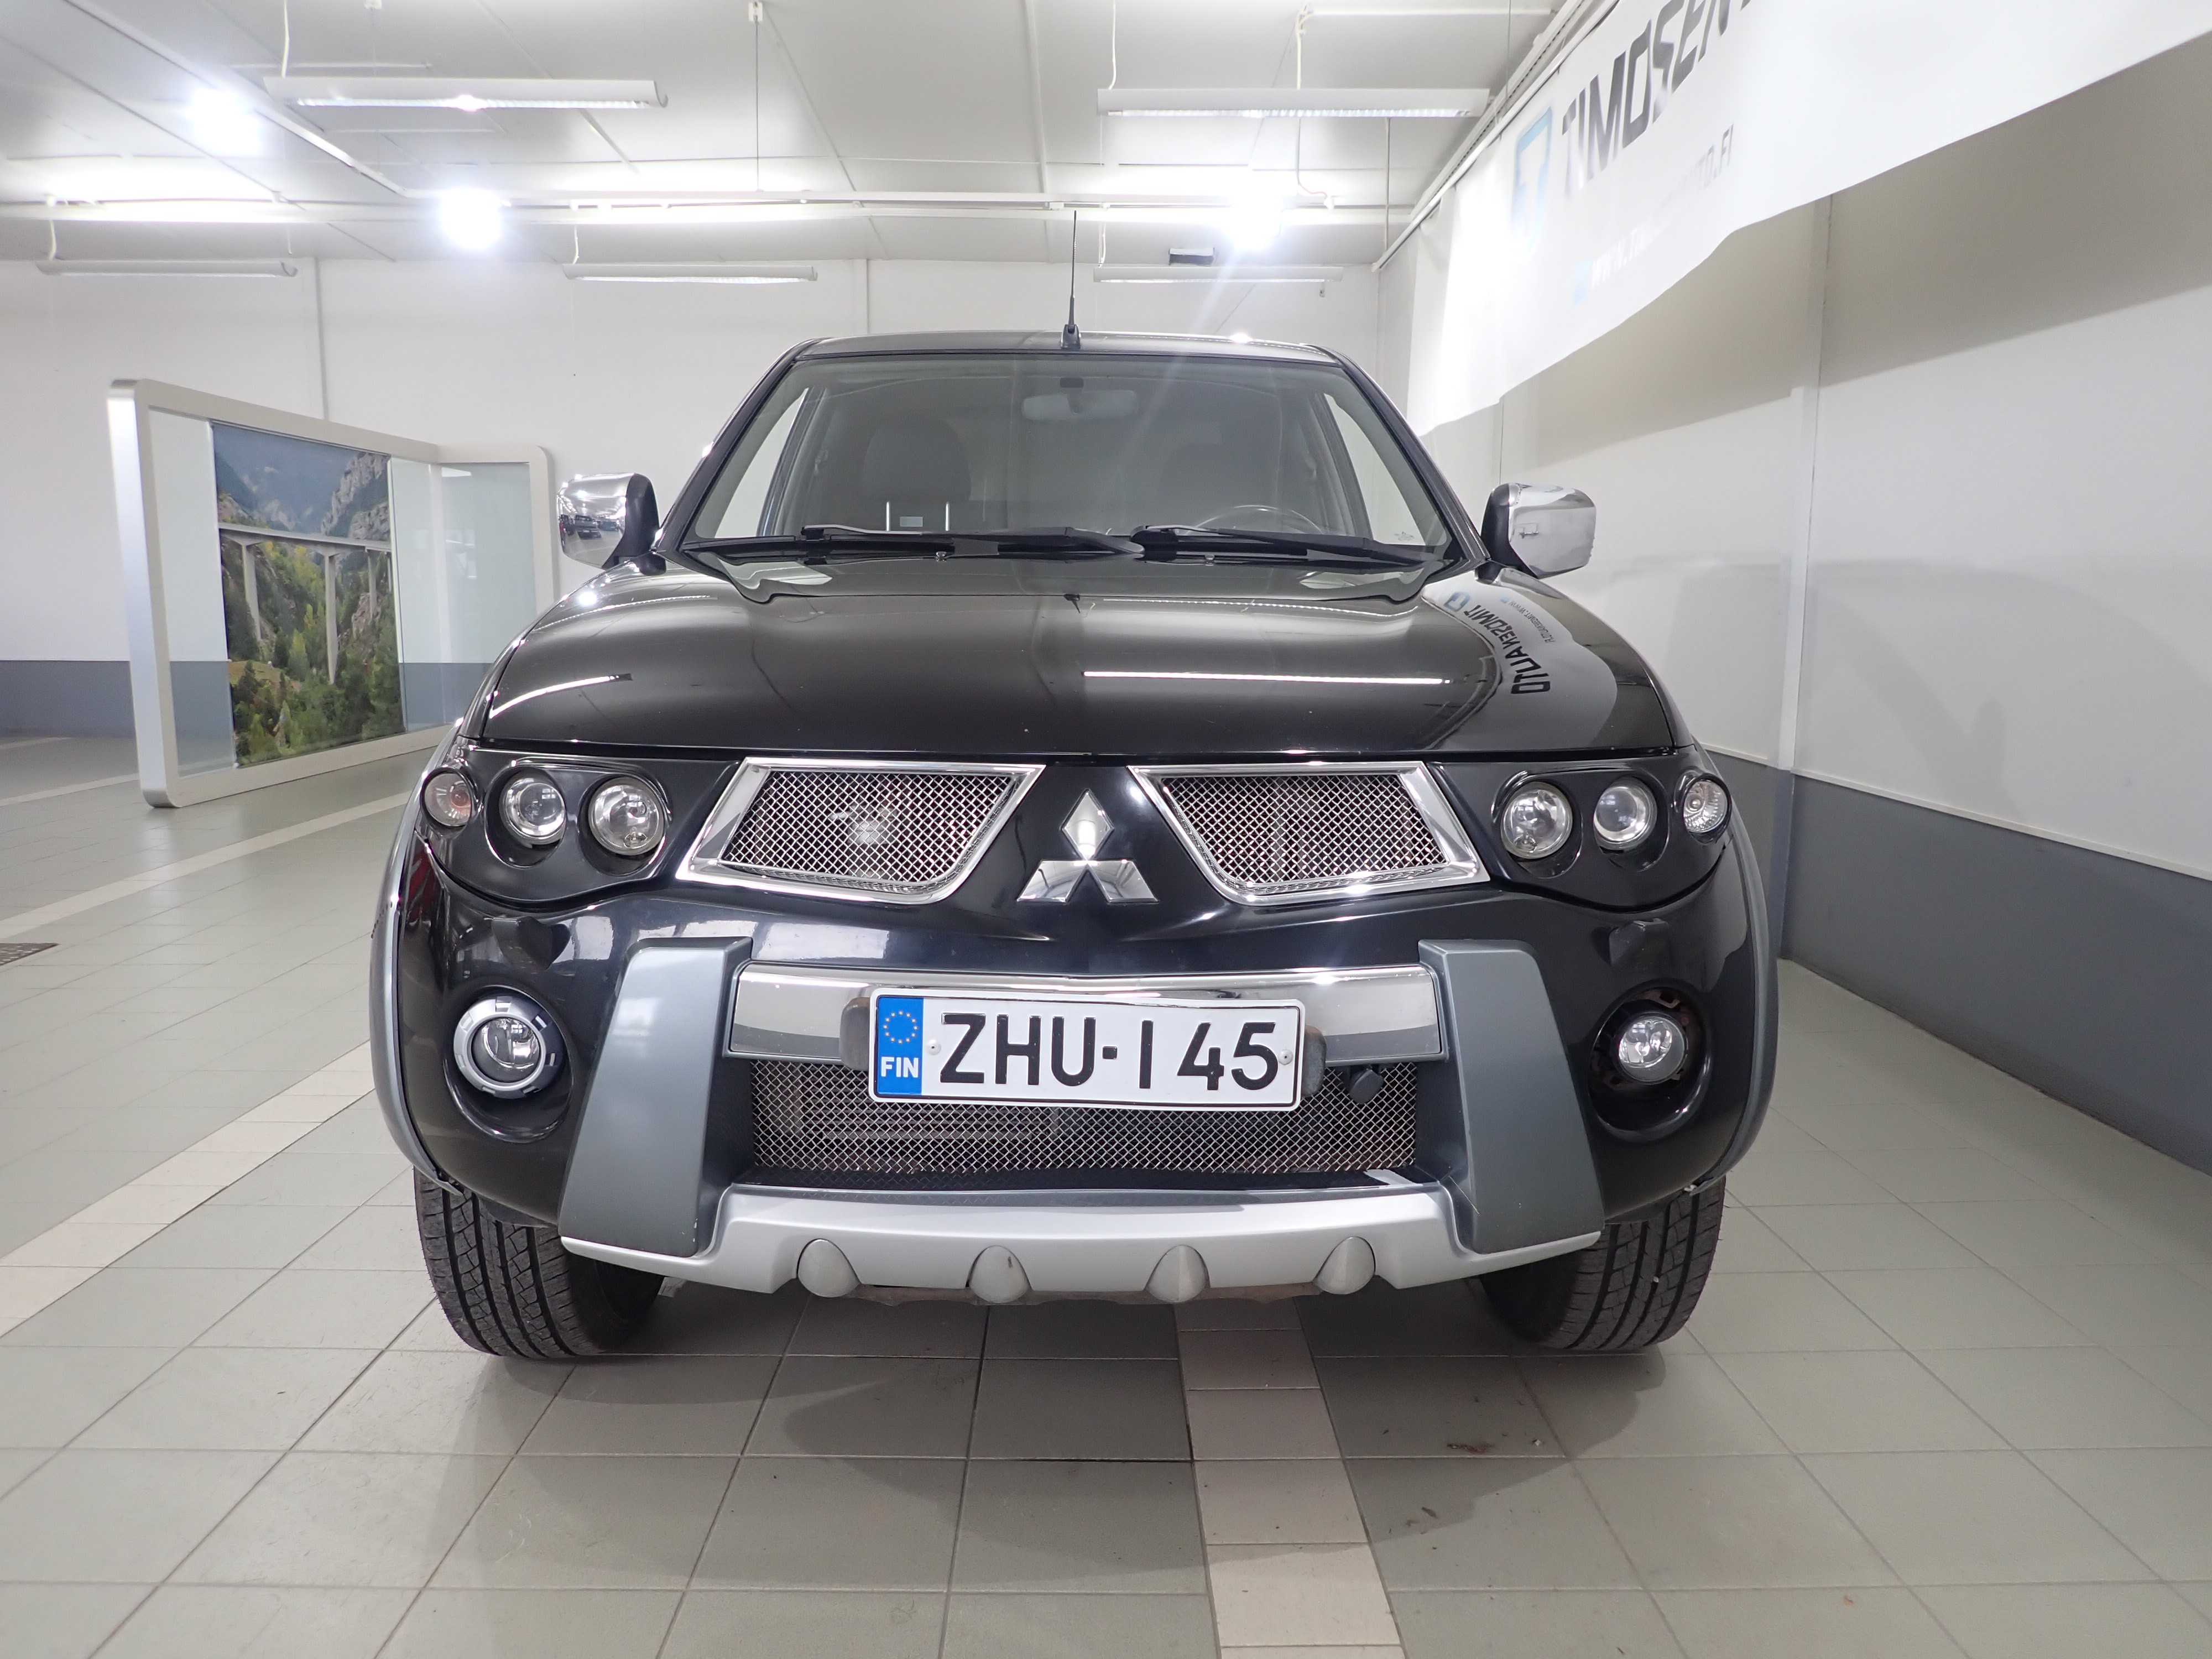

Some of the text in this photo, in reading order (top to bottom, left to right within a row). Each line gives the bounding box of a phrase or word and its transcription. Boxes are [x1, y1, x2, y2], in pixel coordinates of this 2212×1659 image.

[1562, 0, 1752, 201] TIMOSE
[881, 1056, 919, 1078] FIN
[940, 1013, 1278, 1091] ZHU-145
